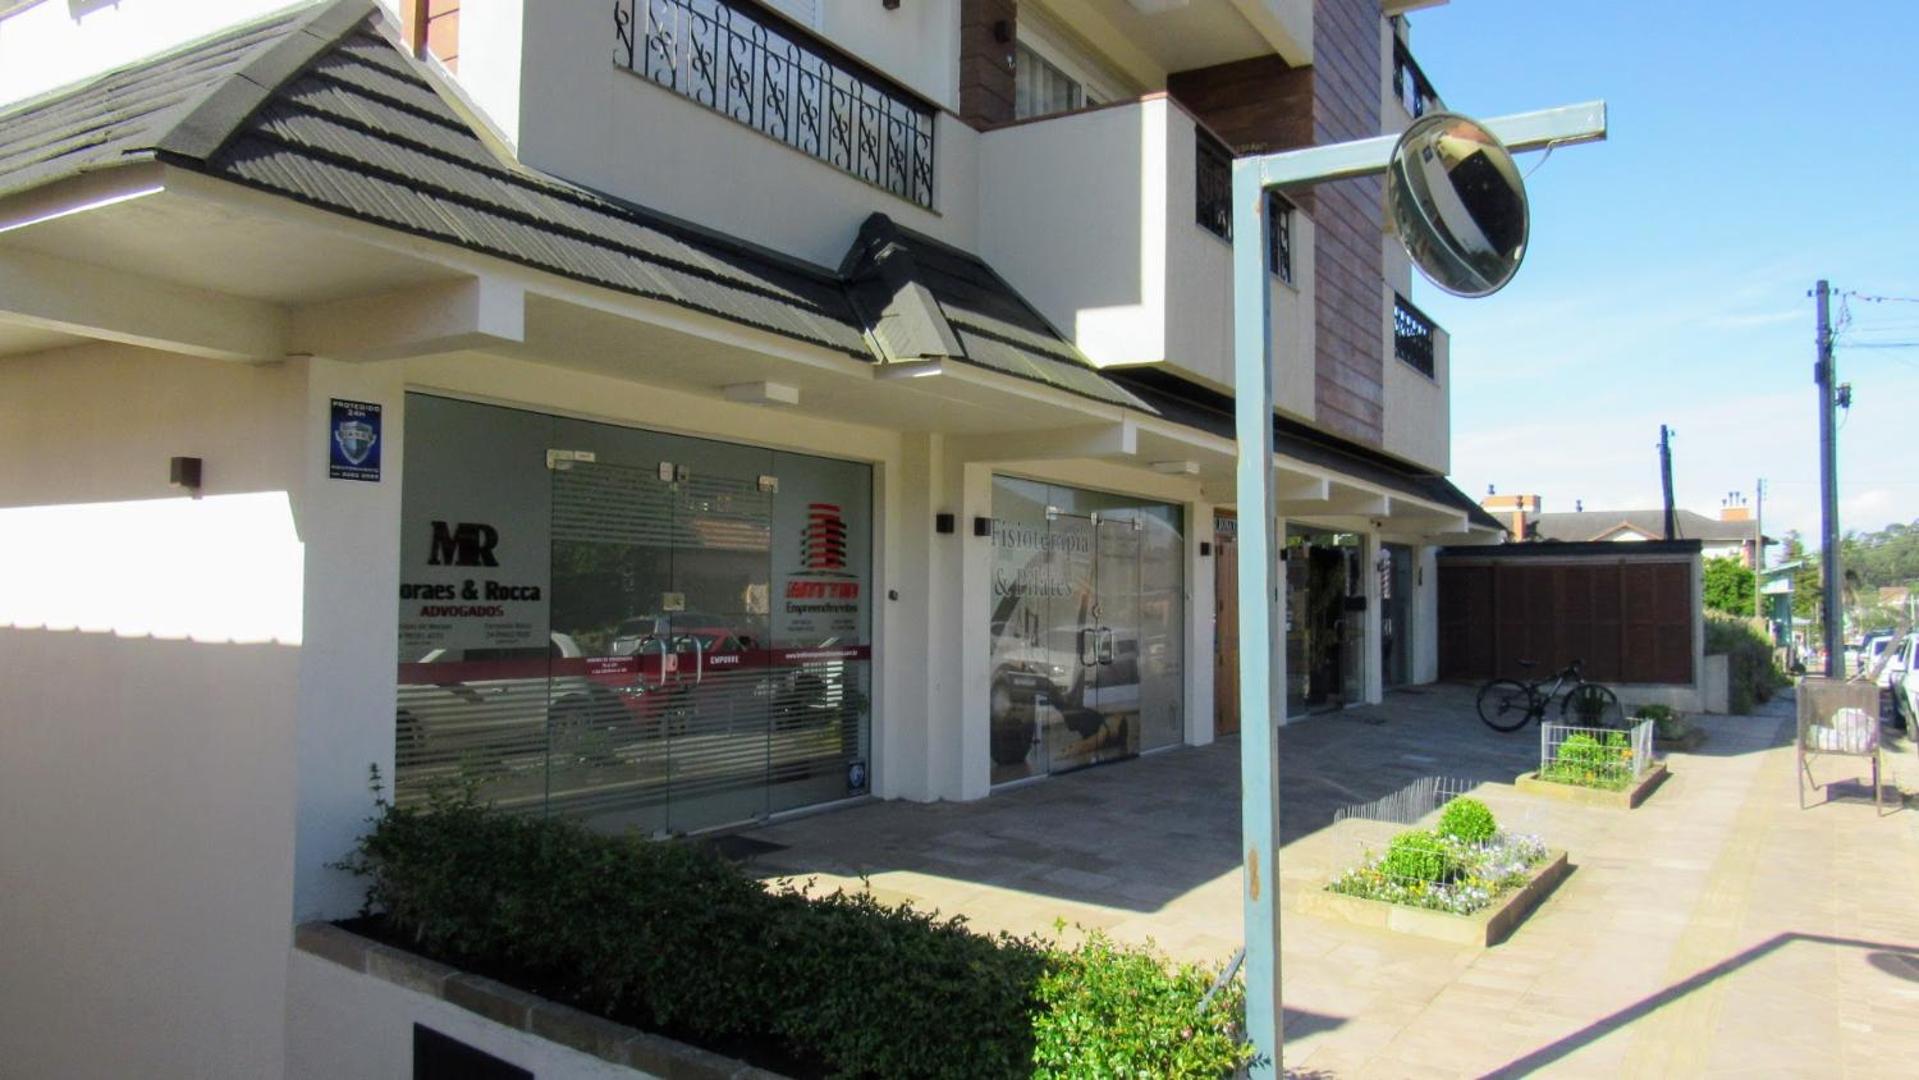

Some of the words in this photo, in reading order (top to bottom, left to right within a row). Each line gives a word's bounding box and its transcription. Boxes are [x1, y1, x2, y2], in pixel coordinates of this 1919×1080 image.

[427, 520, 500, 567] MR
[991, 519, 1089, 559] Fisioterapia
[399, 583, 456, 601] oraes
[461, 579, 479, 600] &
[485, 580, 541, 601] Rocca
[994, 568, 1010, 597] &
[1016, 567, 1073, 598] Pilates
[420, 605, 504, 617] ADVOGADOS
